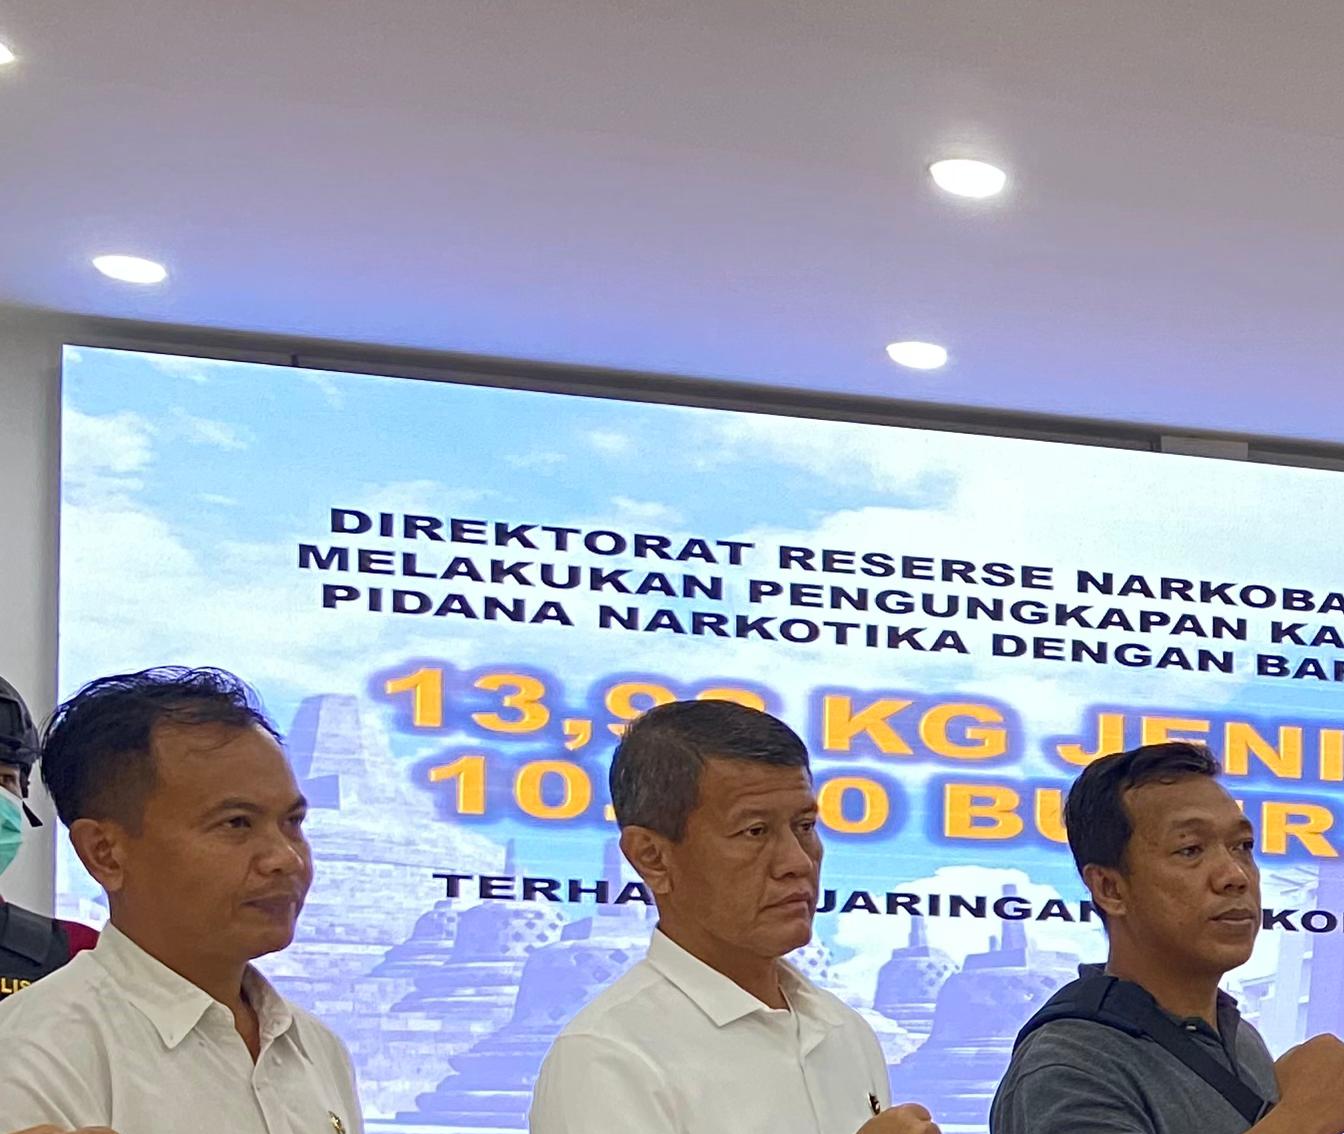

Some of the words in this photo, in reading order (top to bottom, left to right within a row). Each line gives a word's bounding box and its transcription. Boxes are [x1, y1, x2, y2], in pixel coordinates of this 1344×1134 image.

[331, 508, 753, 565] DIREKTORAT
[779, 545, 1053, 590] RESERSE
[298, 543, 722, 600] MELAKUKAN
[749, 579, 1247, 641] PENGUNGKAPAN
[322, 584, 573, 626] PIDANA
[599, 605, 969, 654] NARKOTIKA
[992, 633, 1233, 674] DENGAN
[823, 694, 1008, 761] KG
[432, 874, 656, 906] TERHA
